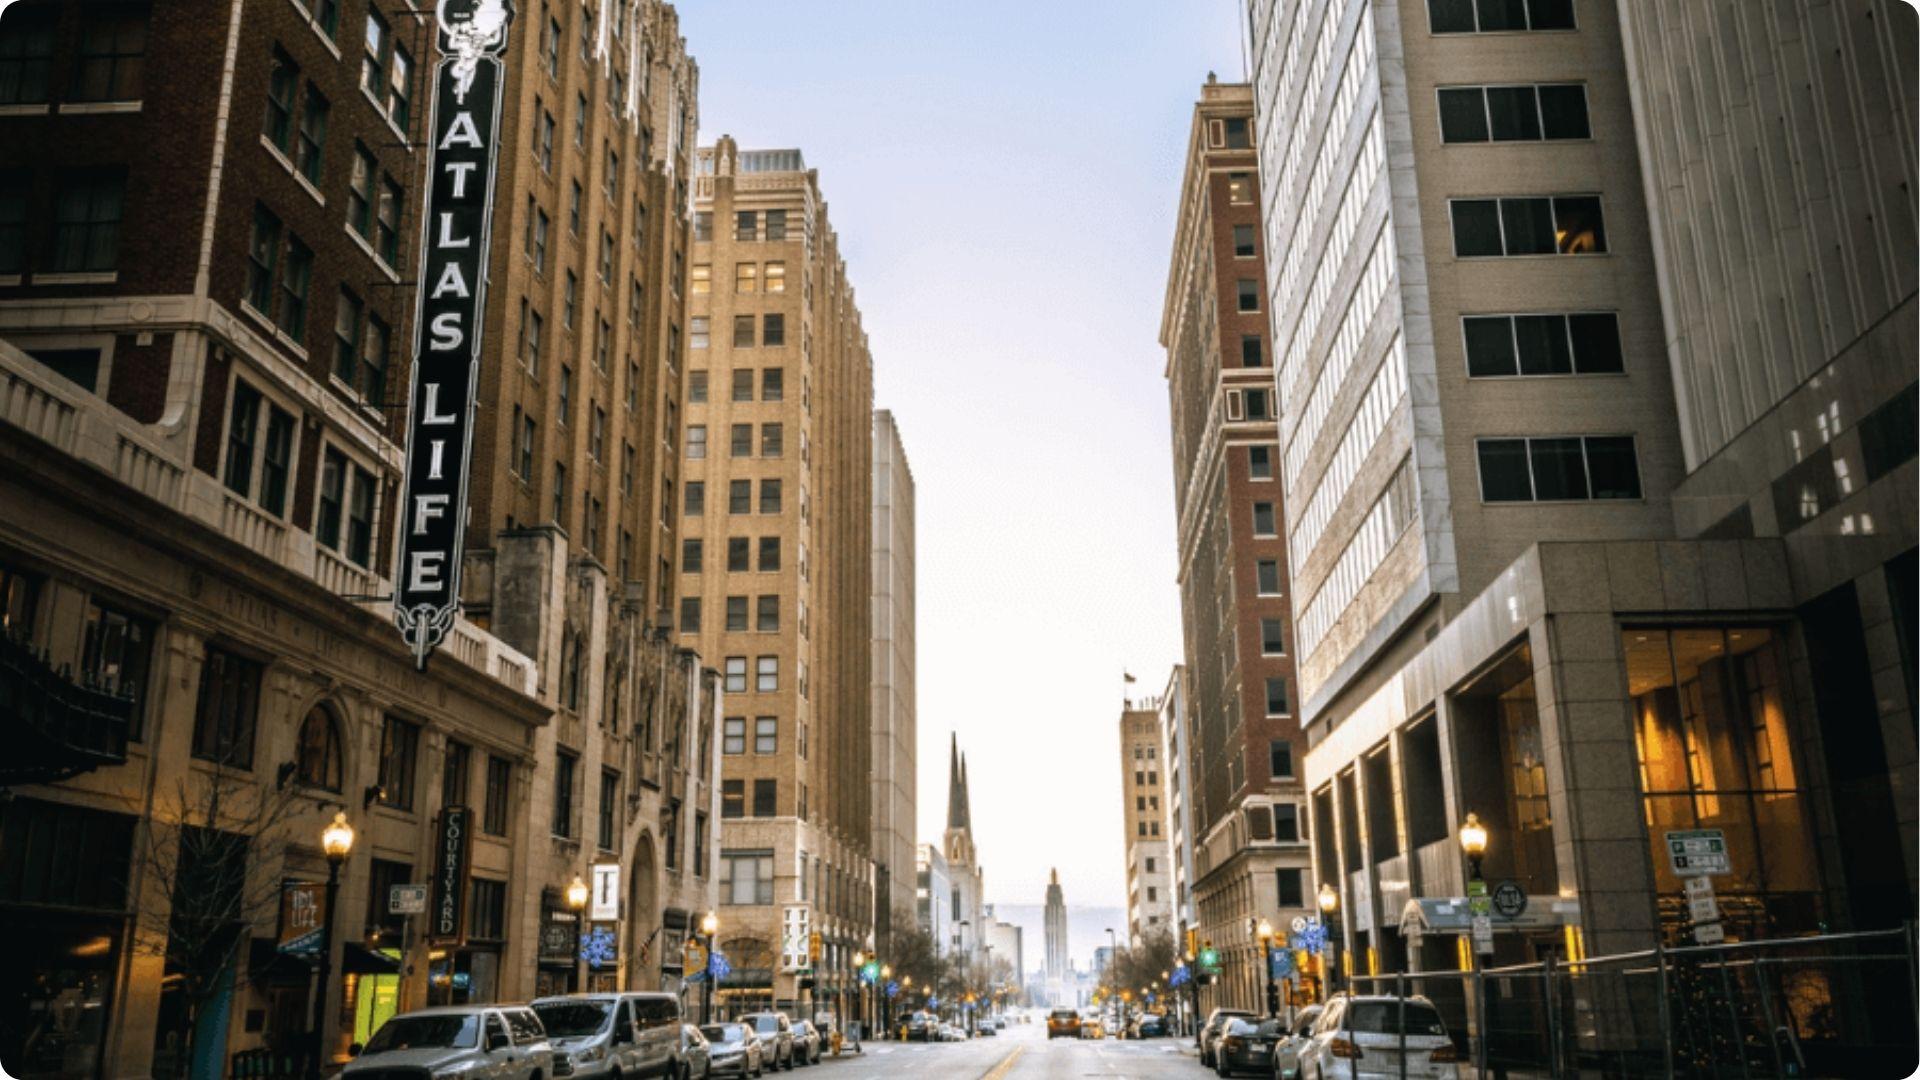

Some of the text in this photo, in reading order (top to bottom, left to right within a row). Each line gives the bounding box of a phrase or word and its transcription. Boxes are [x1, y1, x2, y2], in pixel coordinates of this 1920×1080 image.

[408, 111, 484, 592] ATLAS LIFE
[440, 813, 461, 934] COURTYARD
